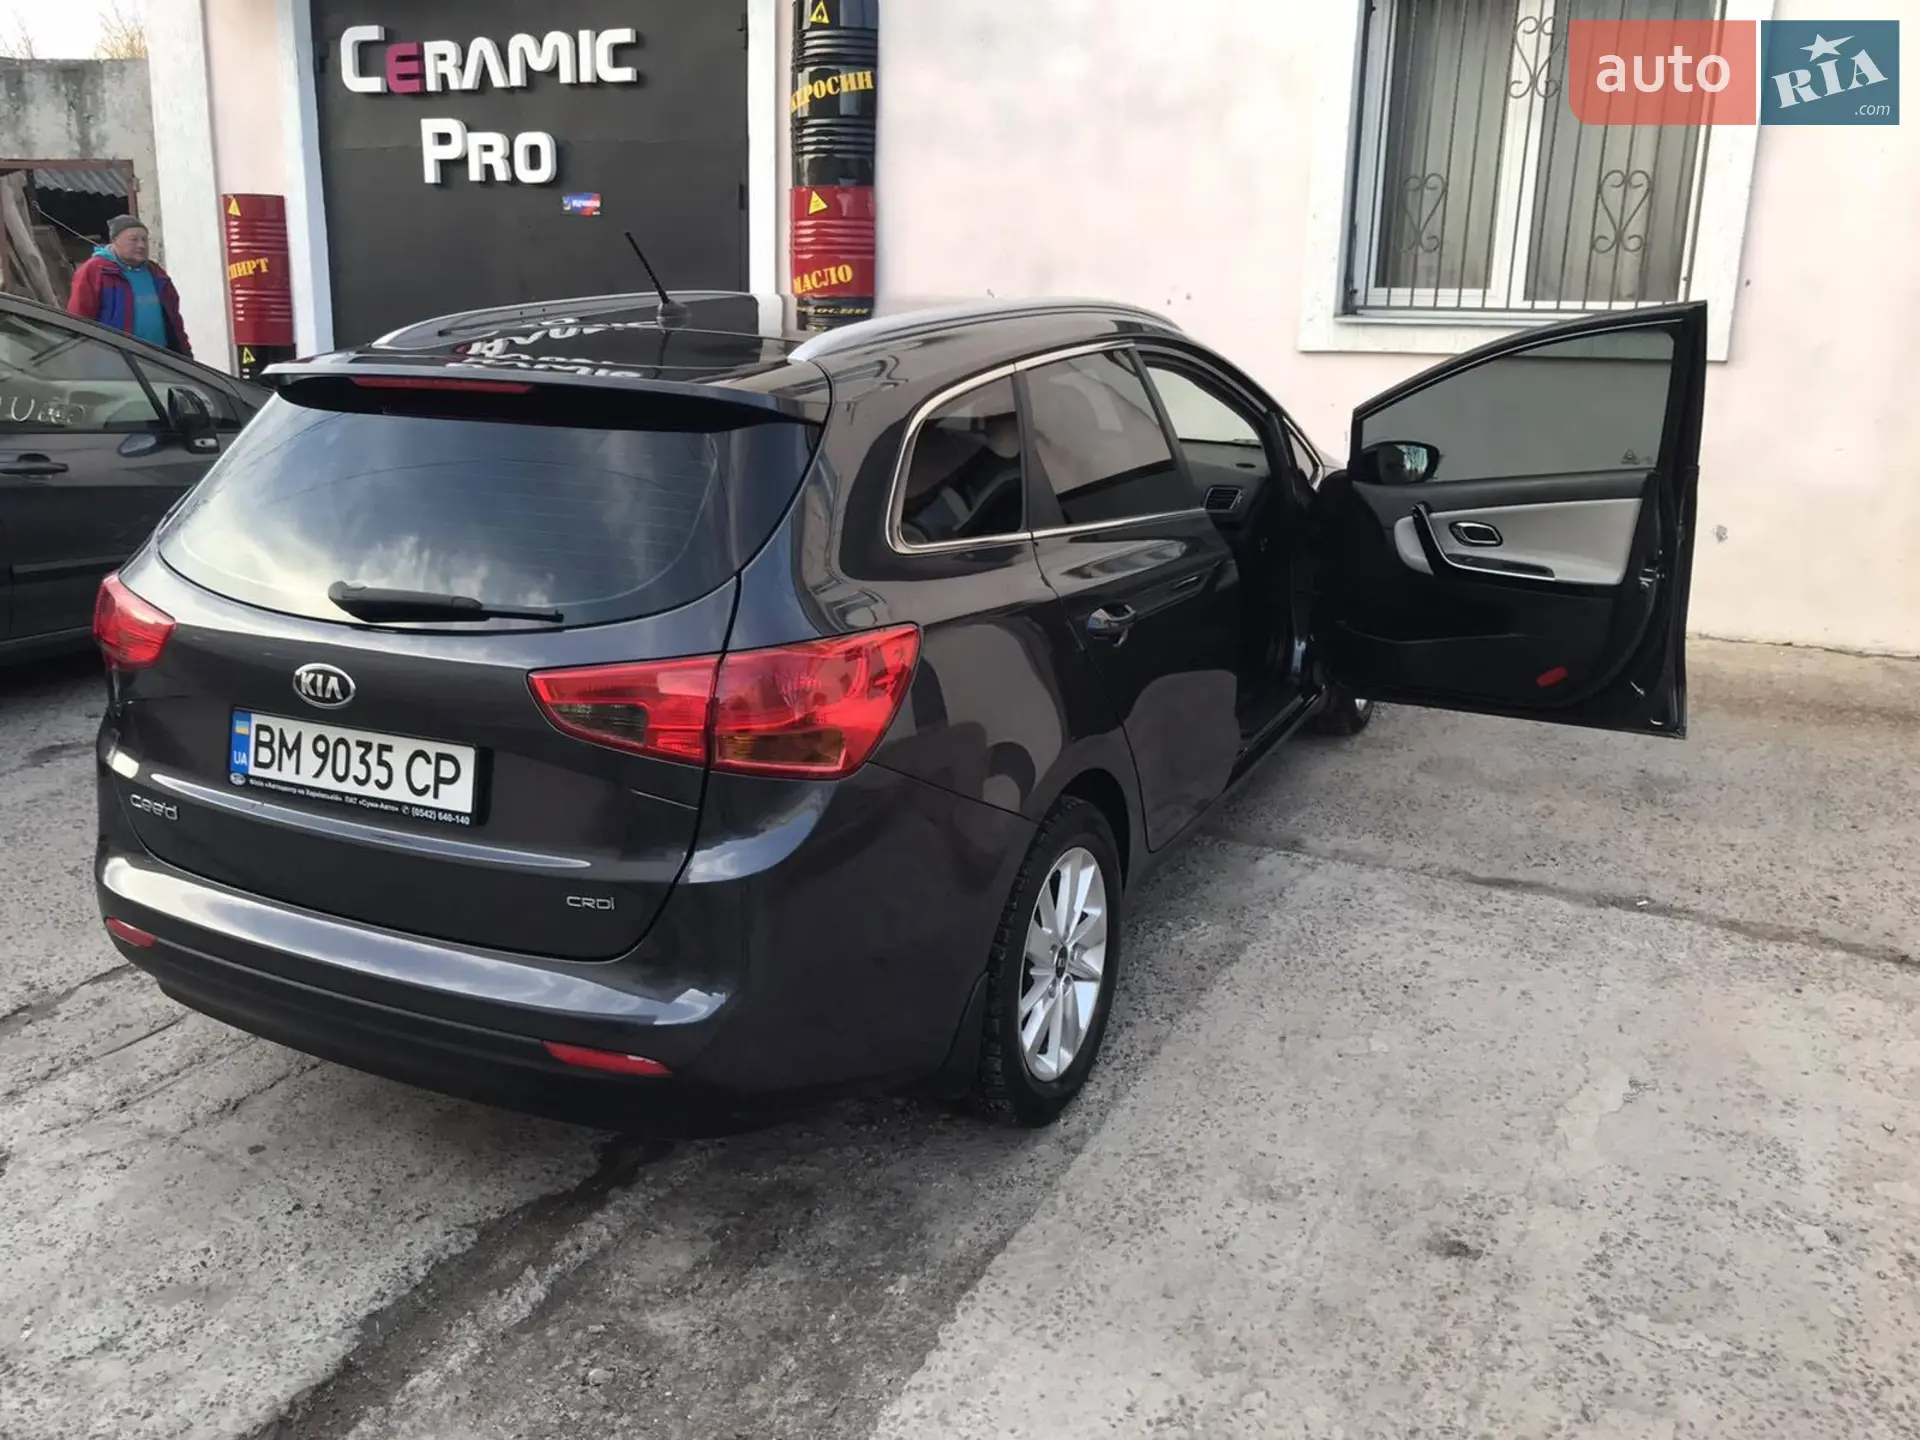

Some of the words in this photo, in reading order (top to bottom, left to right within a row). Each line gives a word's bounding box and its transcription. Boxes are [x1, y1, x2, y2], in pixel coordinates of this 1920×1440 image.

[341, 24, 638, 93] CERAMIC
[228, 257, 269, 280] ПИРТ
[301, 671, 343, 700] KIA
[233, 750, 248, 765] UA
[254, 723, 302, 775] BM
[311, 734, 393, 790] 9035
[405, 749, 462, 799] CP
